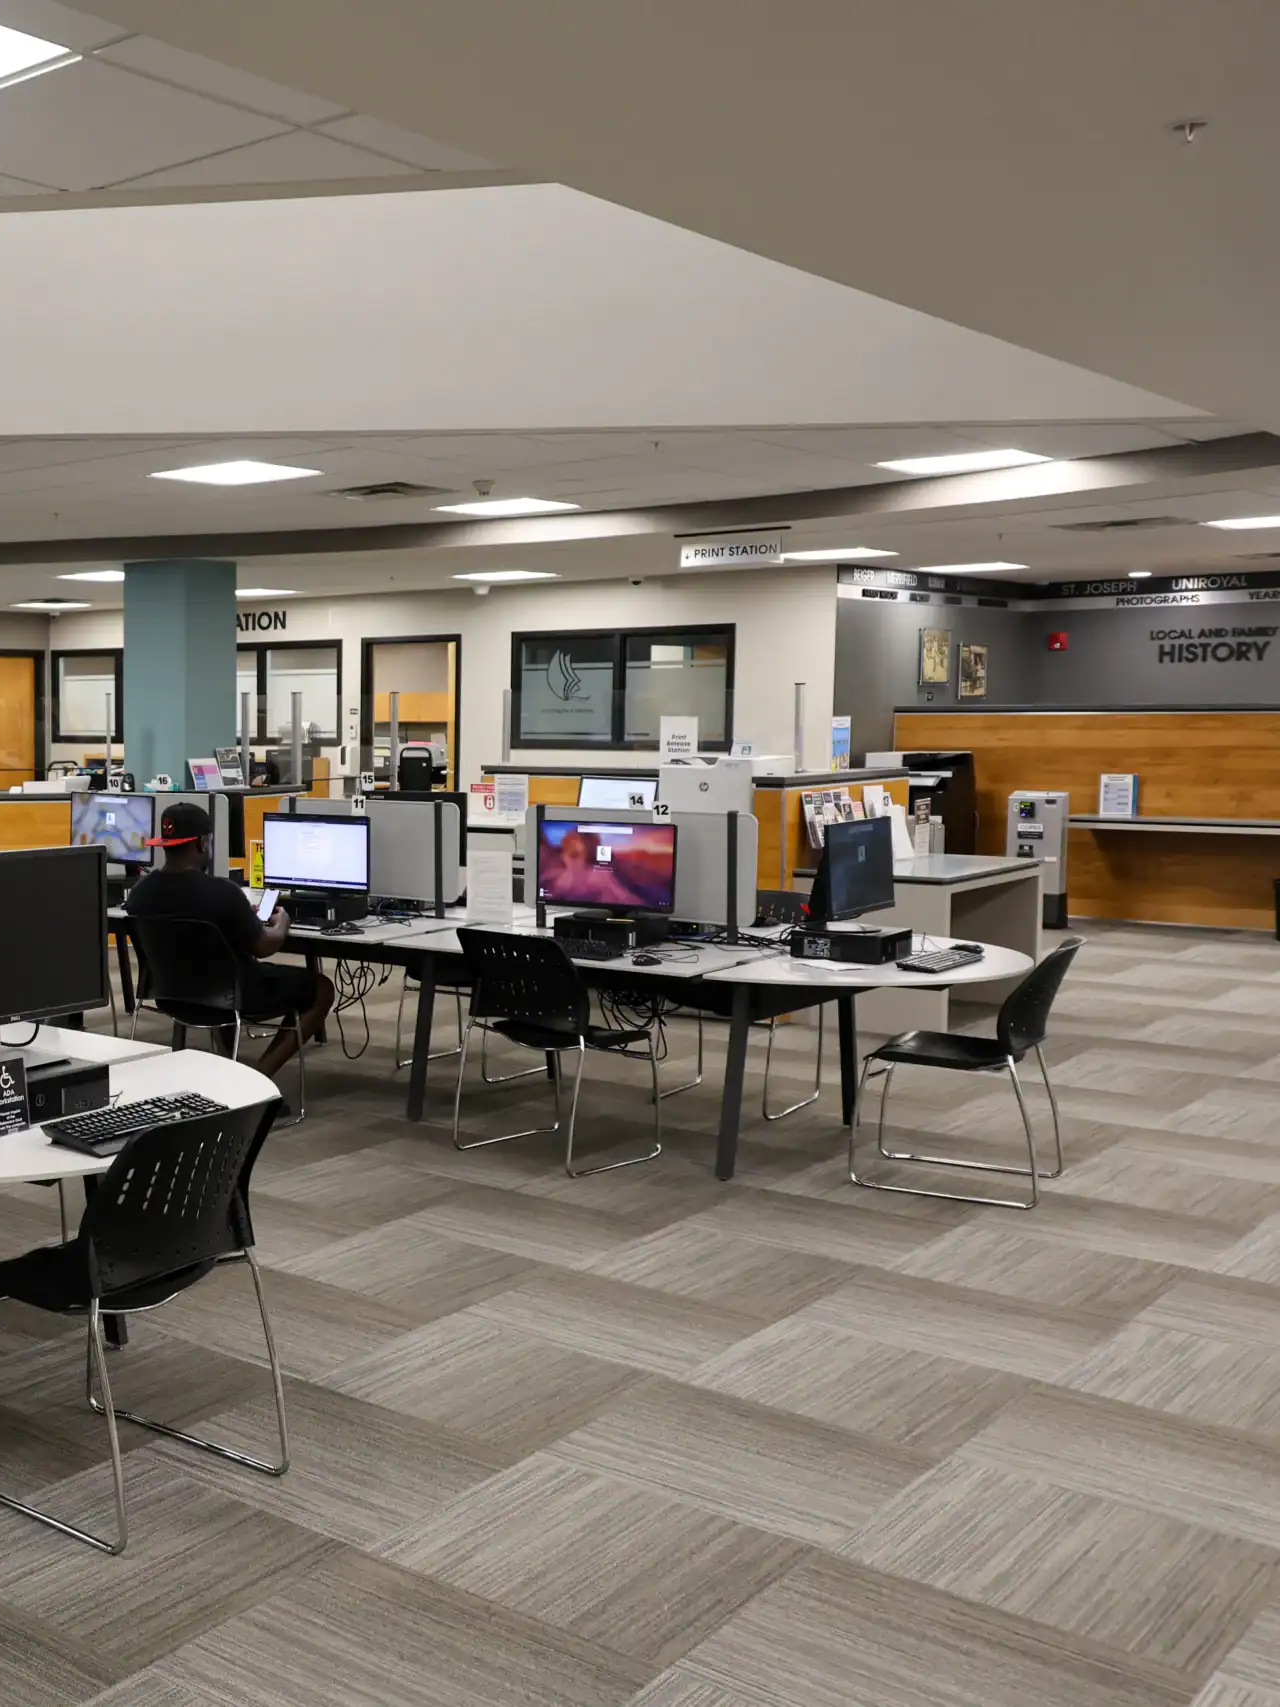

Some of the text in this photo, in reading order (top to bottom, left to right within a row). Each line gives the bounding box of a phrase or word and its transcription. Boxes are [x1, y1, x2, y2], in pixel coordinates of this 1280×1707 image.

[694, 544, 778, 559] PRINT STATION
[1061, 580, 1138, 596] ST. JOSEPH
[1172, 576, 1248, 590] UNIROYAL
[1115, 593, 1201, 606] PHOTOGRAPHS
[1150, 628, 1194, 641] LOCAL
[1197, 627, 1229, 639] AND
[1158, 640, 1271, 664] HISTORY
[109, 778, 119, 788] 10
[158, 776, 168, 785] 16
[362, 774, 374, 784] 15
[353, 798, 365, 809] 11
[629, 795, 644, 806] 14
[653, 804, 669, 816] 12
[3, 1089, 15, 1097] ADA
